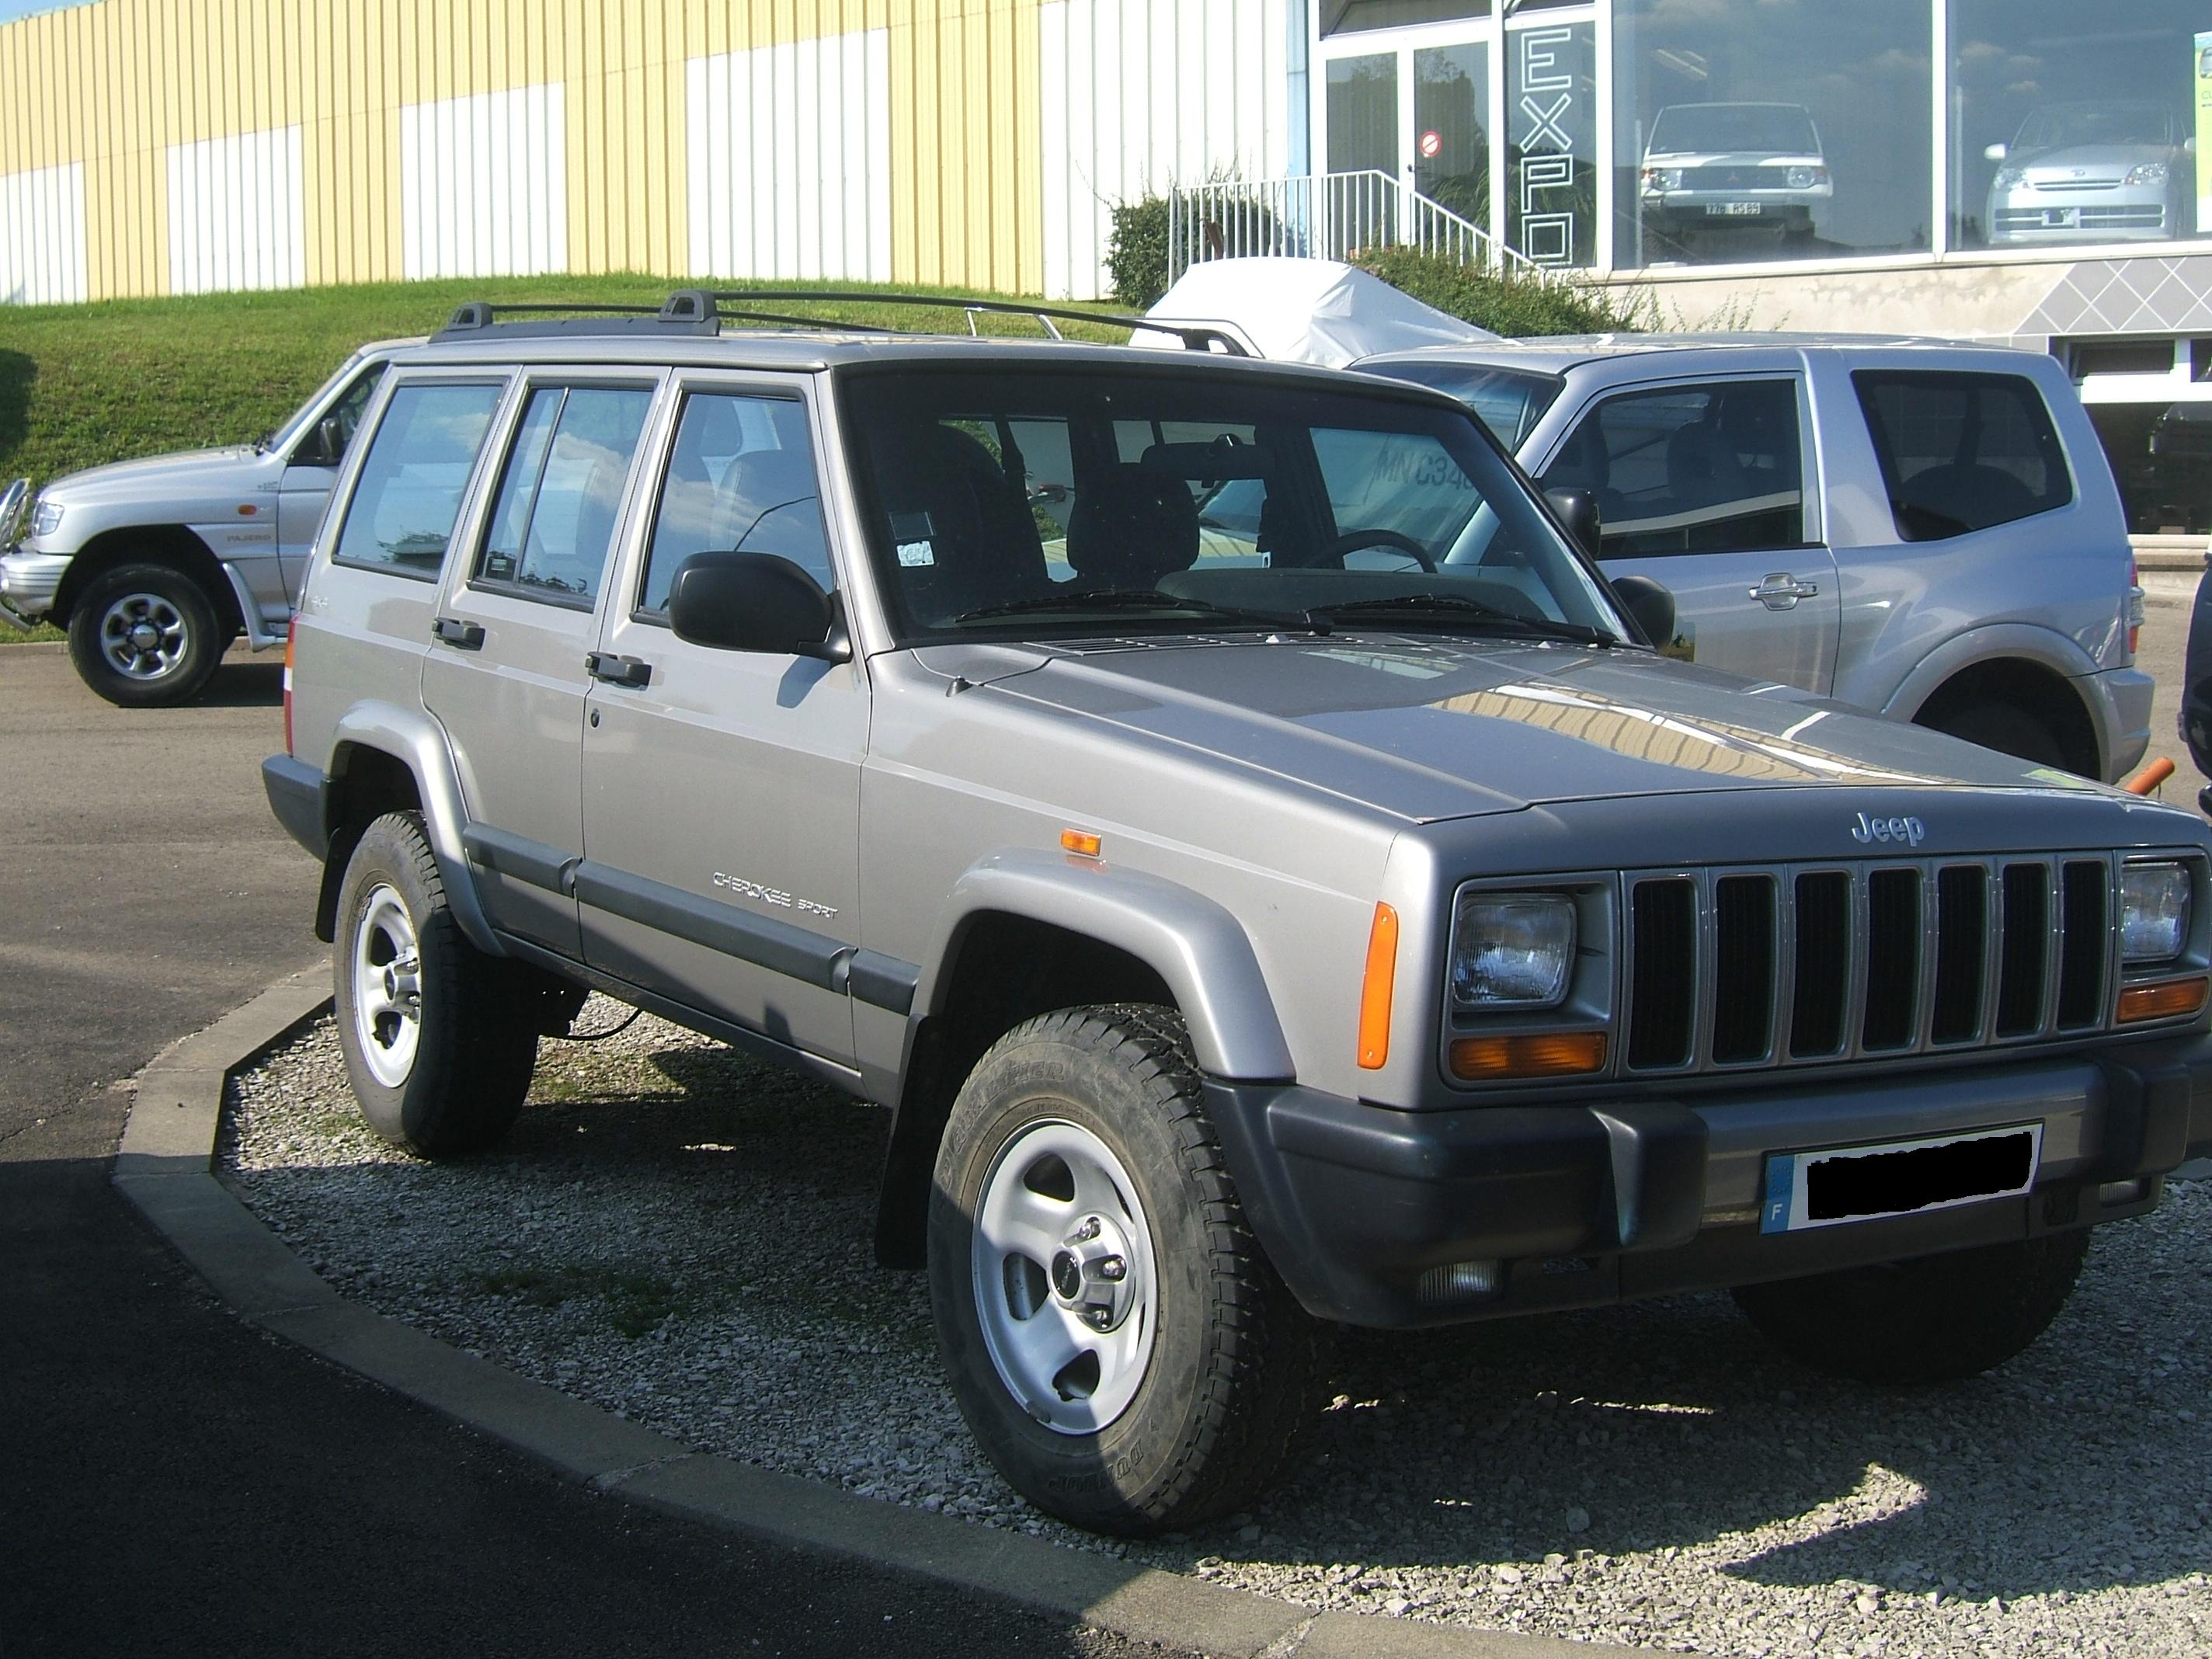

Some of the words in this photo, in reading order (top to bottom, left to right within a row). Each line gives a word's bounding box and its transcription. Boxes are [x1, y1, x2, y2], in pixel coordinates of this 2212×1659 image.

[1520, 27, 1574, 265] EXPO
[1851, 812, 1925, 847] Jeep
[713, 871, 791, 908] CHEROKEE
[798, 899, 839, 919] SPORT
[1770, 1203, 1782, 1221] F
